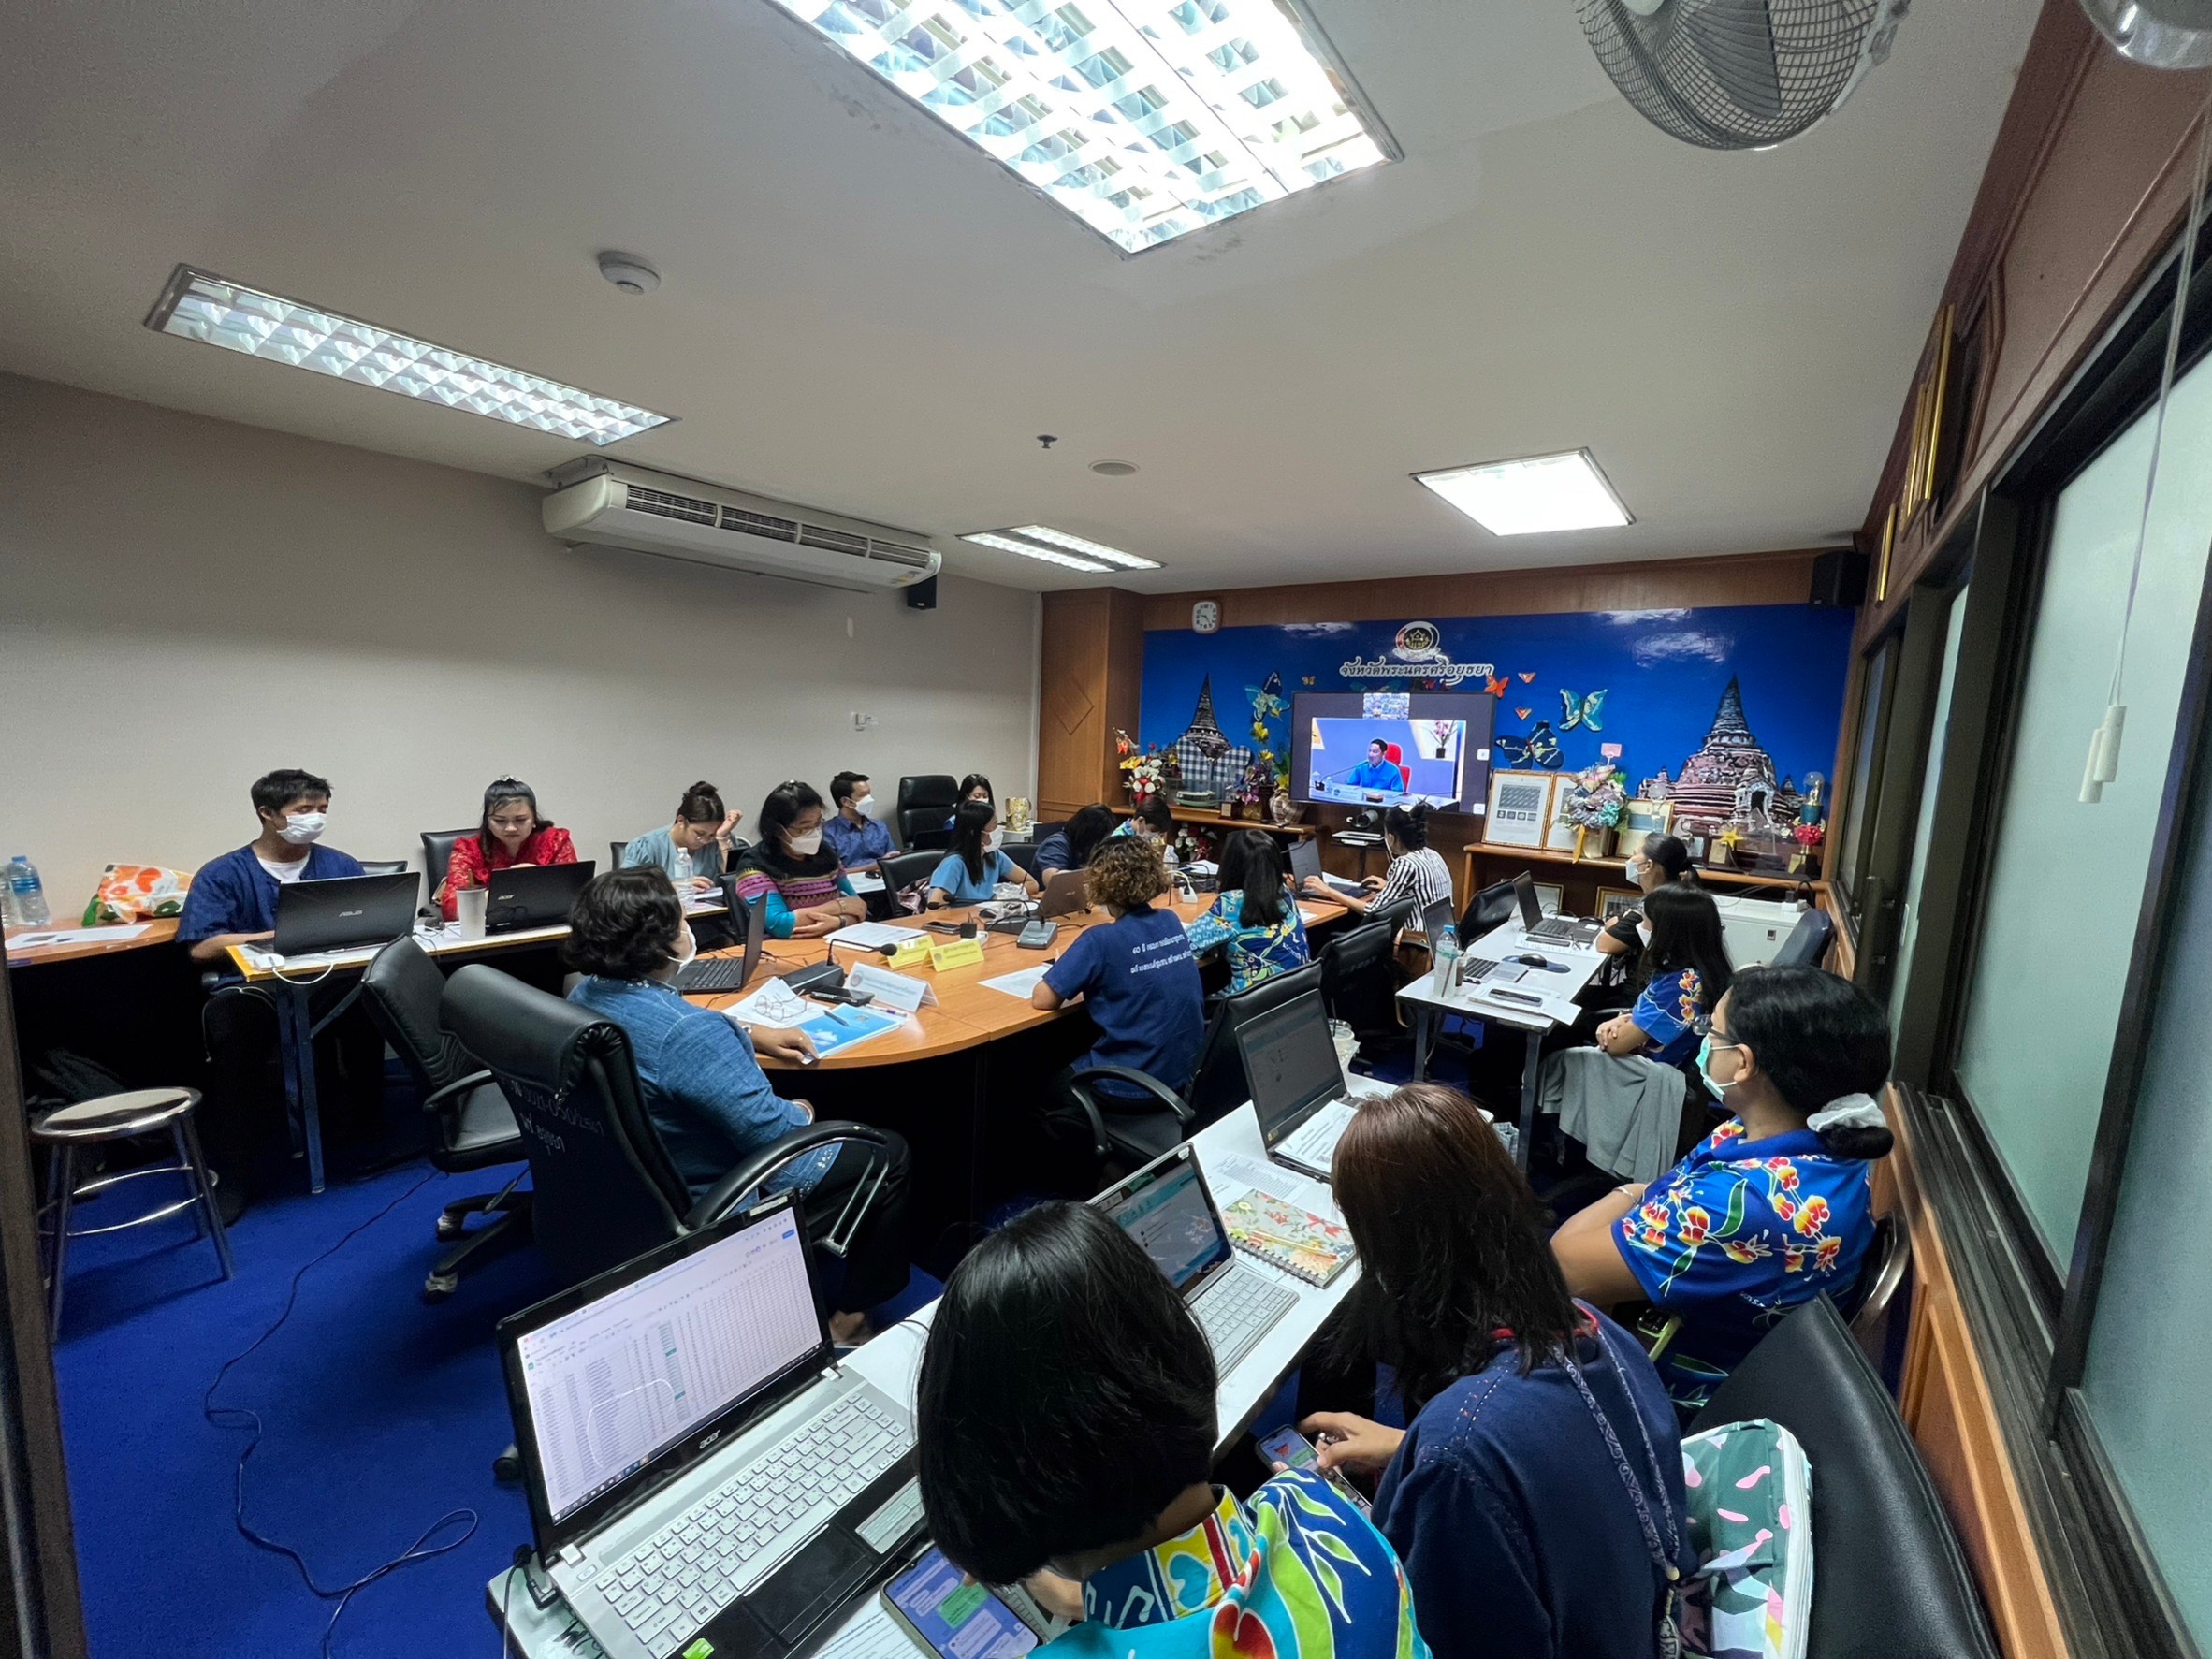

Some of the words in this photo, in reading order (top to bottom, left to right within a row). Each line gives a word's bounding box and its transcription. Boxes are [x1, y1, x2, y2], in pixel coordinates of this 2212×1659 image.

[1339, 654, 1494, 687] จังหวัดพระนครศรีอยุธยา
[699, 1429, 720, 1449] acer
